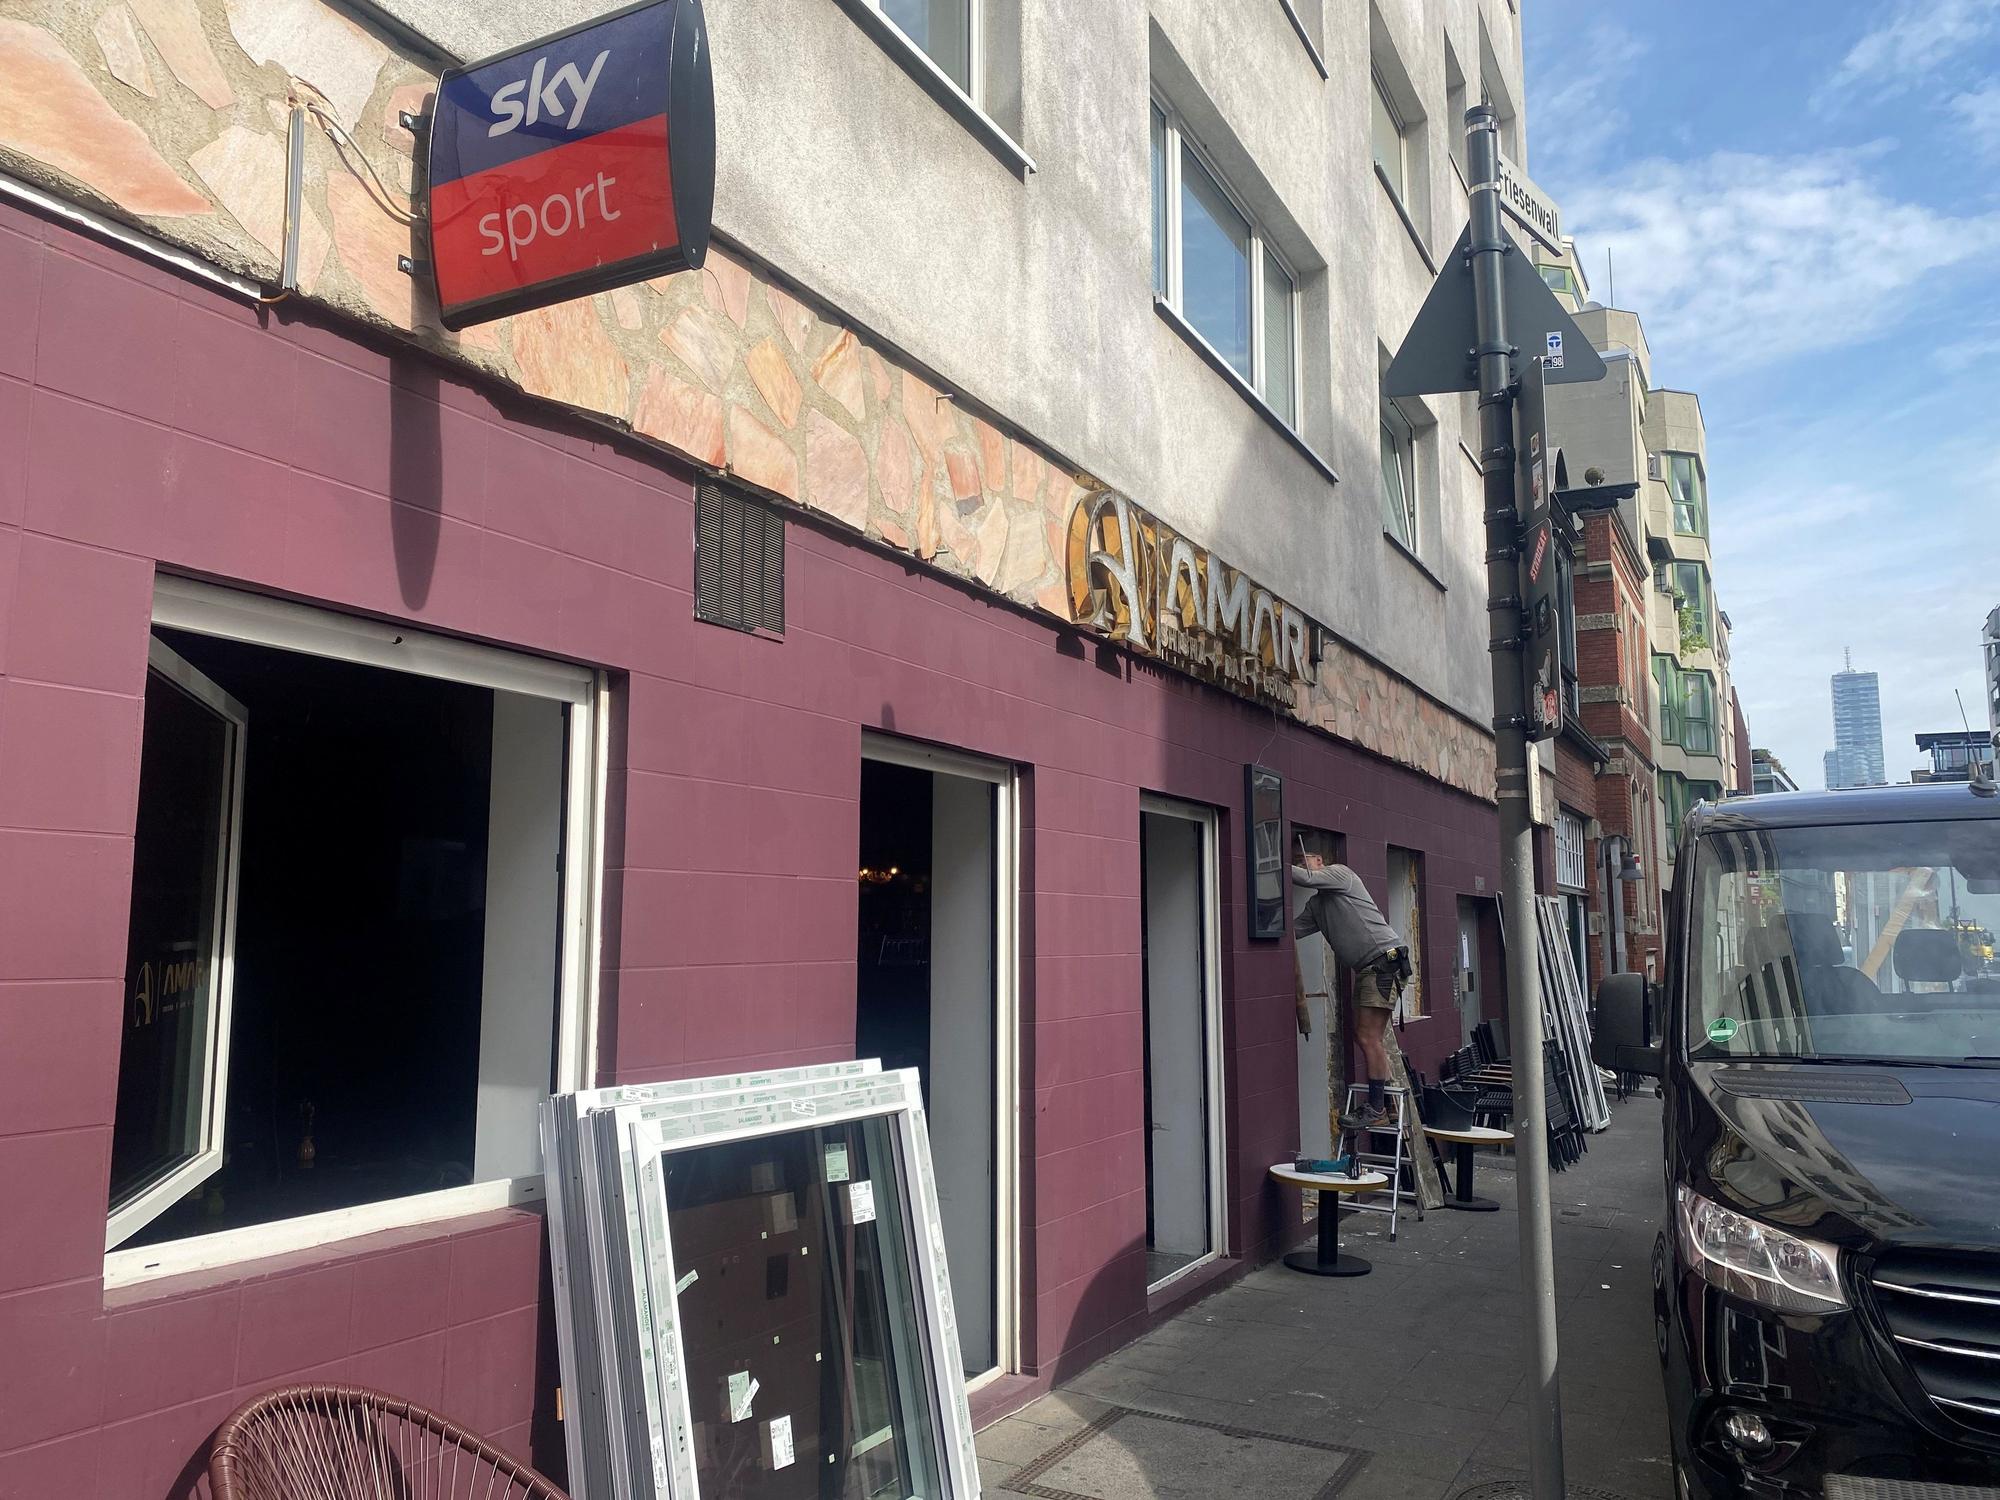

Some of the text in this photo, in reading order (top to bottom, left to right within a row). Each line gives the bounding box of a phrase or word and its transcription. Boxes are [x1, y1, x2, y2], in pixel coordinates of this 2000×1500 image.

[487, 49, 610, 138] sky
[478, 171, 622, 261] sport
[1552, 356, 1563, 368] 98
